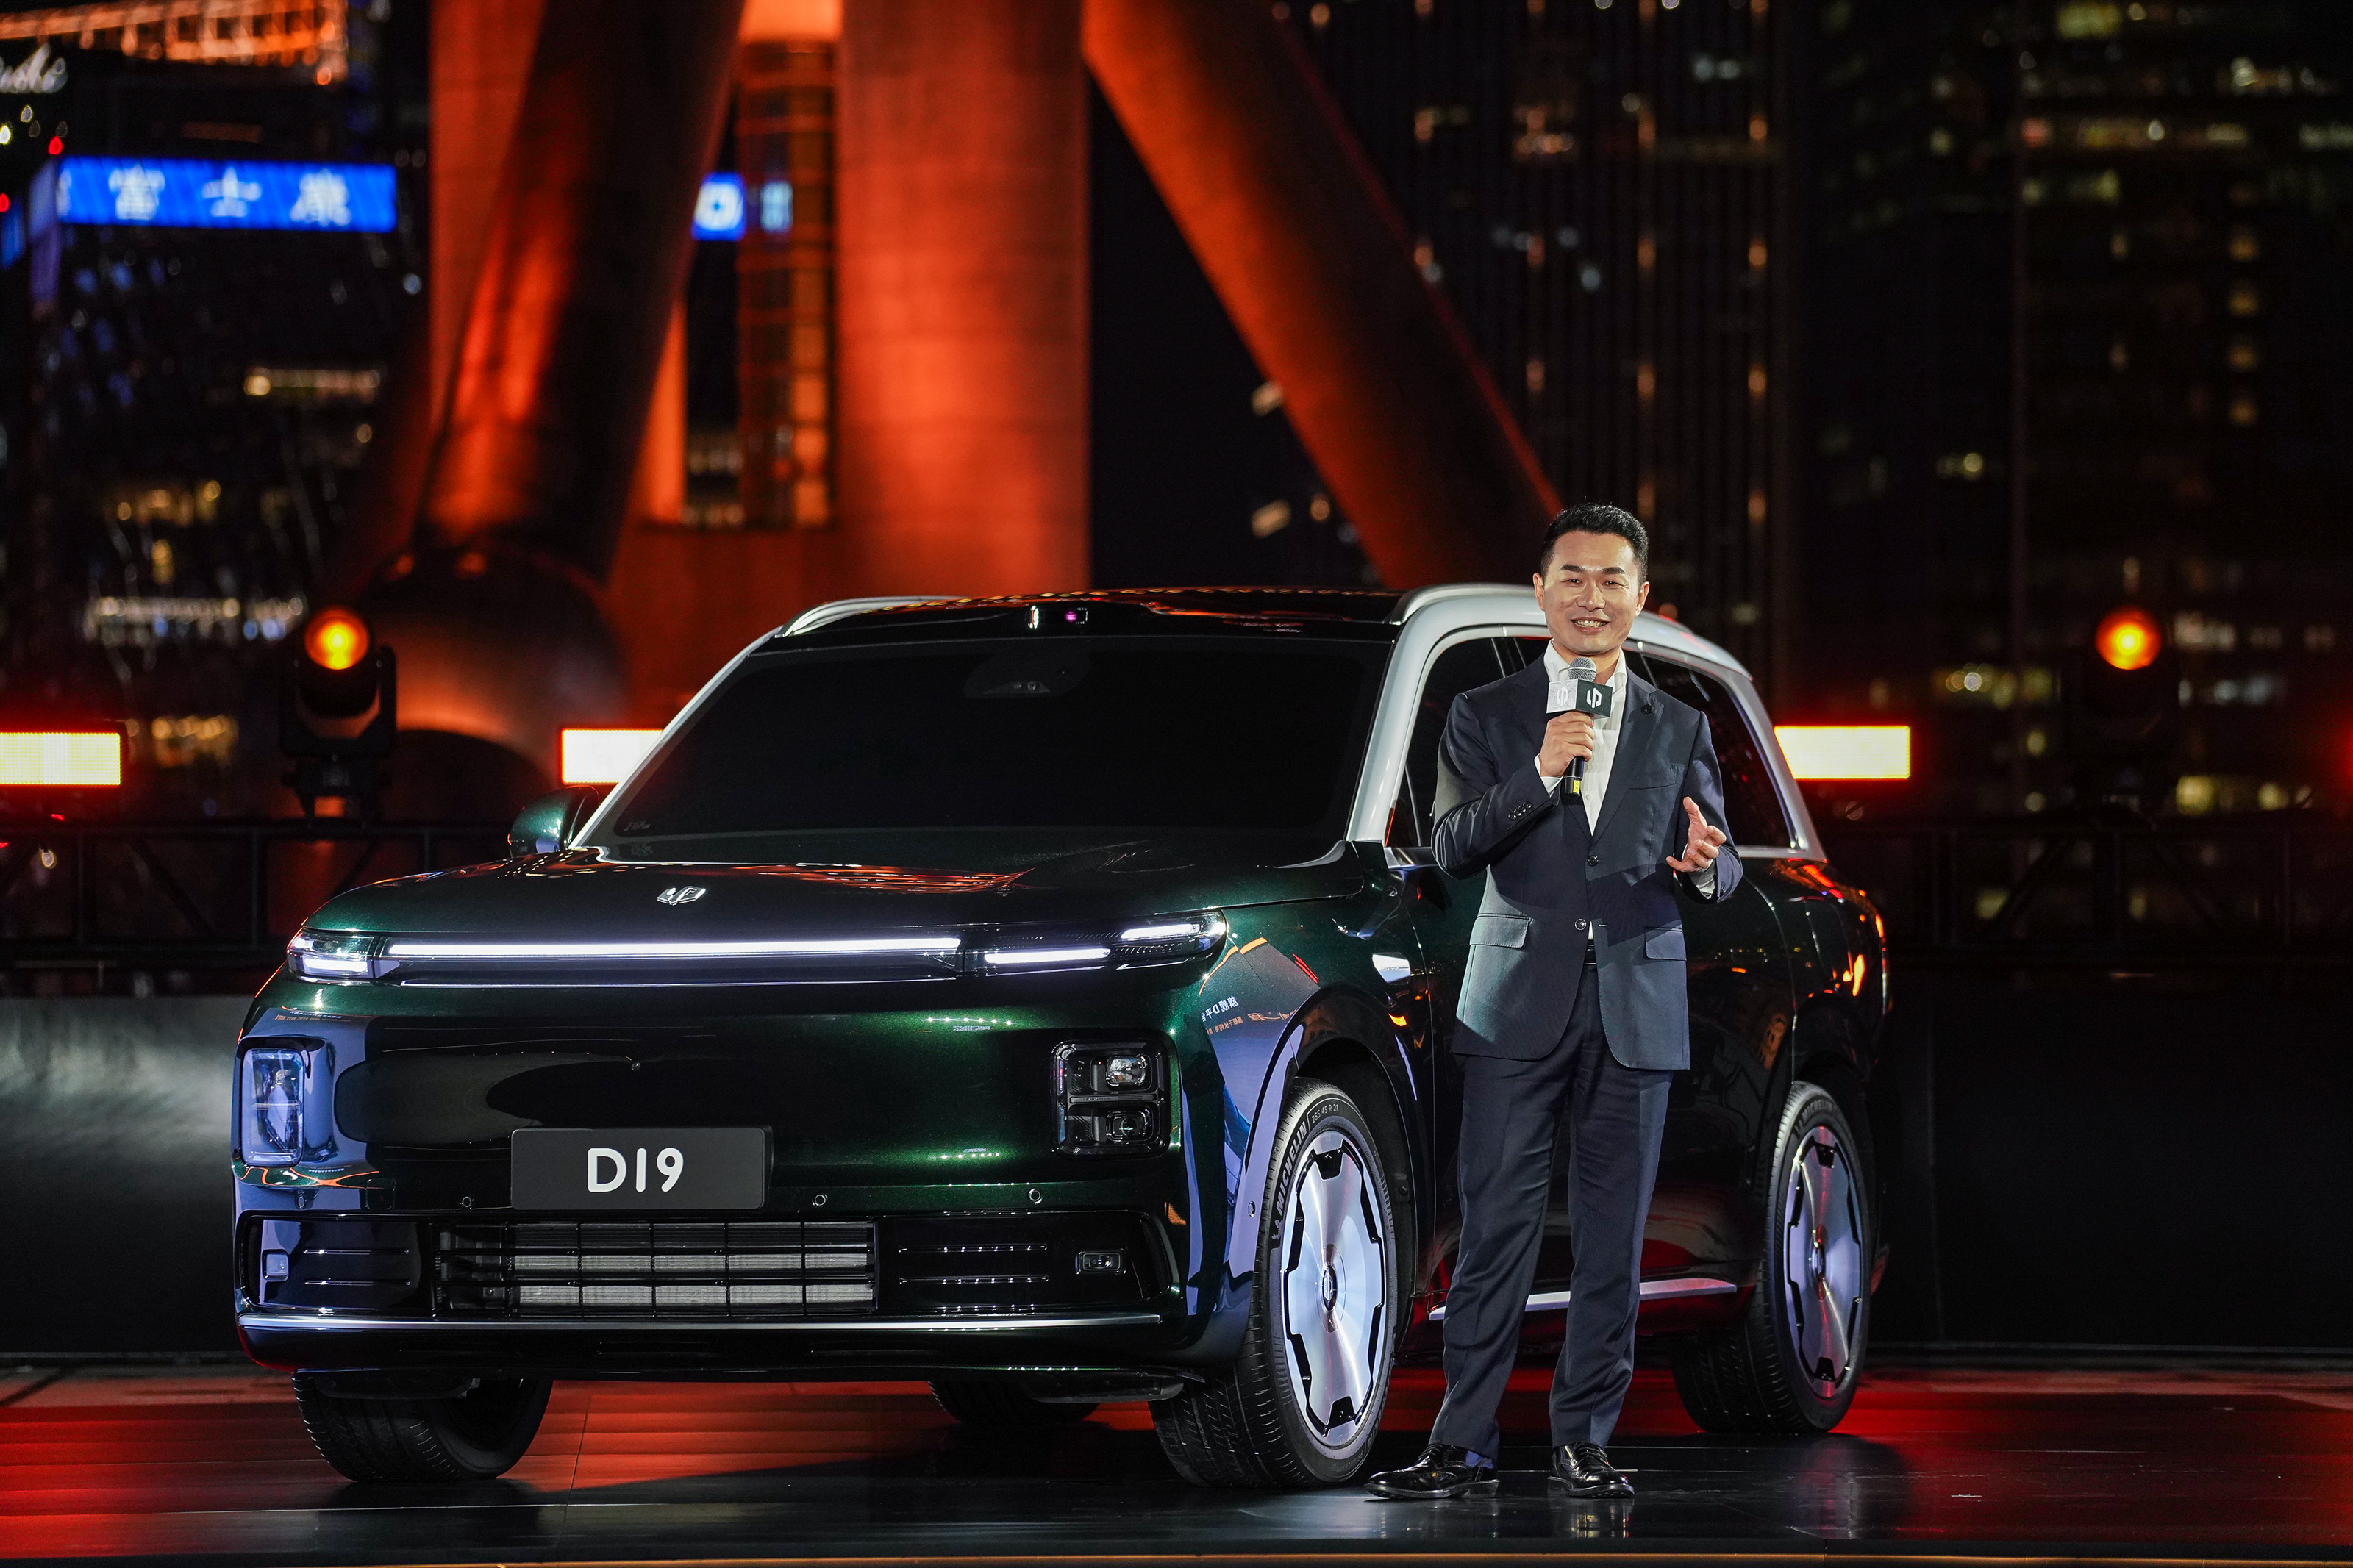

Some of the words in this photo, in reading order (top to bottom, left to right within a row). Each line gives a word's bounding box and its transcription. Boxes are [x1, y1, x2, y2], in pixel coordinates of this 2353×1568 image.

[1333, 1103, 1338, 1111] 21
[588, 1147, 684, 1192] D19
[1277, 1121, 1307, 1217] MICHELIN
